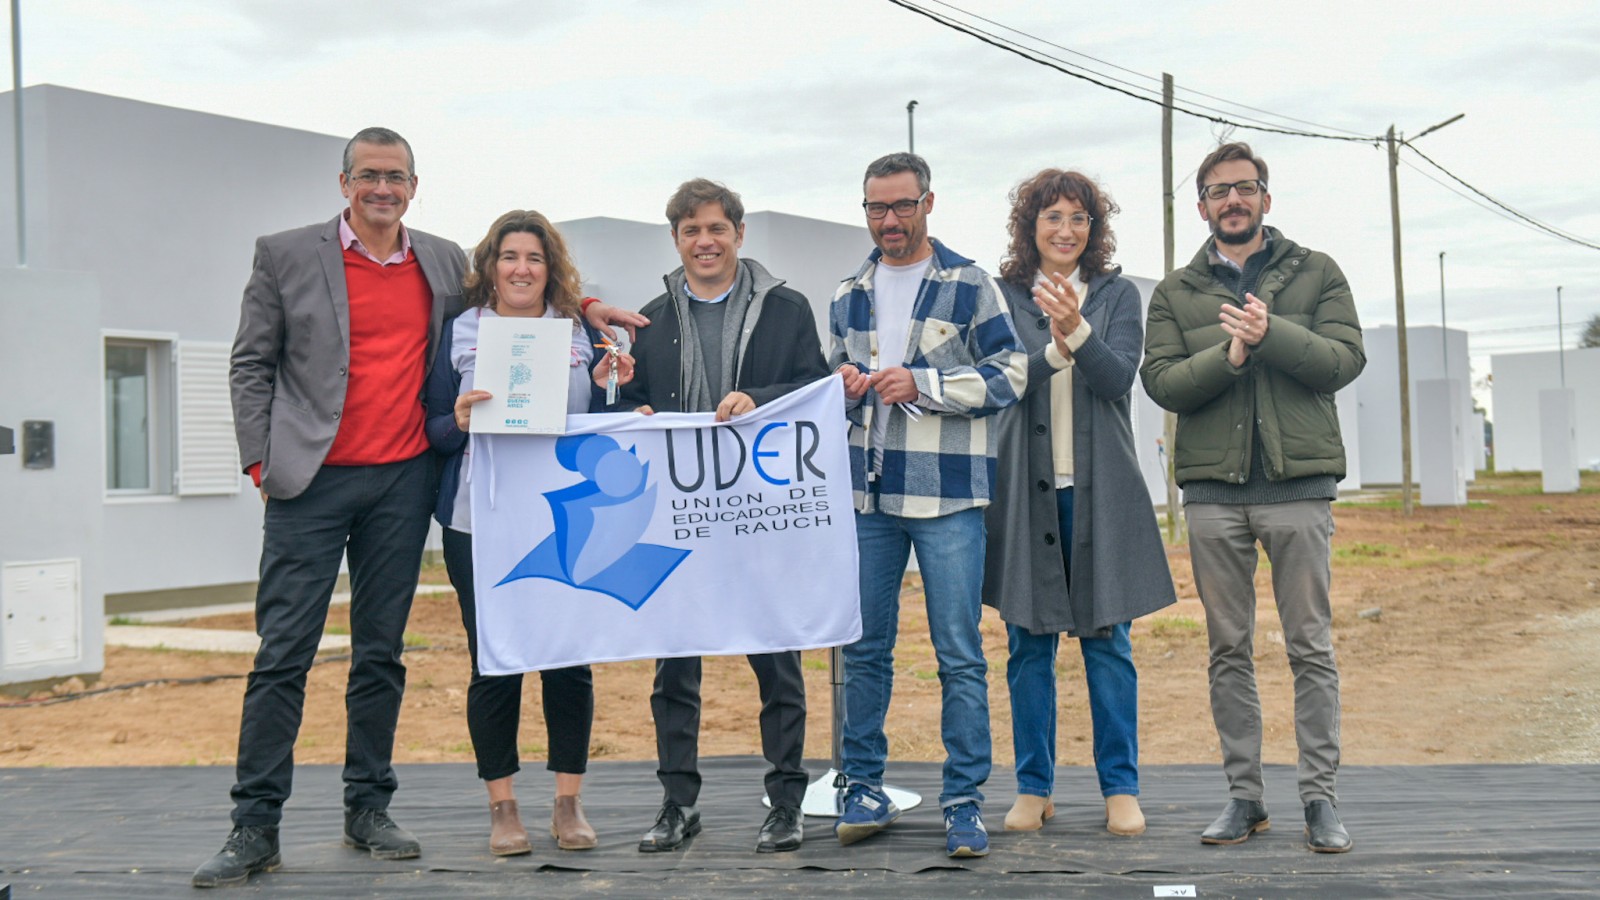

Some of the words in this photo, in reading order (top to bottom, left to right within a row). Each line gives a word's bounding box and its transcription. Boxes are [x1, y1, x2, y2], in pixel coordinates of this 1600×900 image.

[665, 421, 826, 493] UDER
[672, 492, 763, 511] UNION
[789, 485, 828, 500] DE
[673, 501, 829, 525] EDUCADORES
[674, 526, 711, 540] DE
[735, 515, 832, 536] RAUCH
